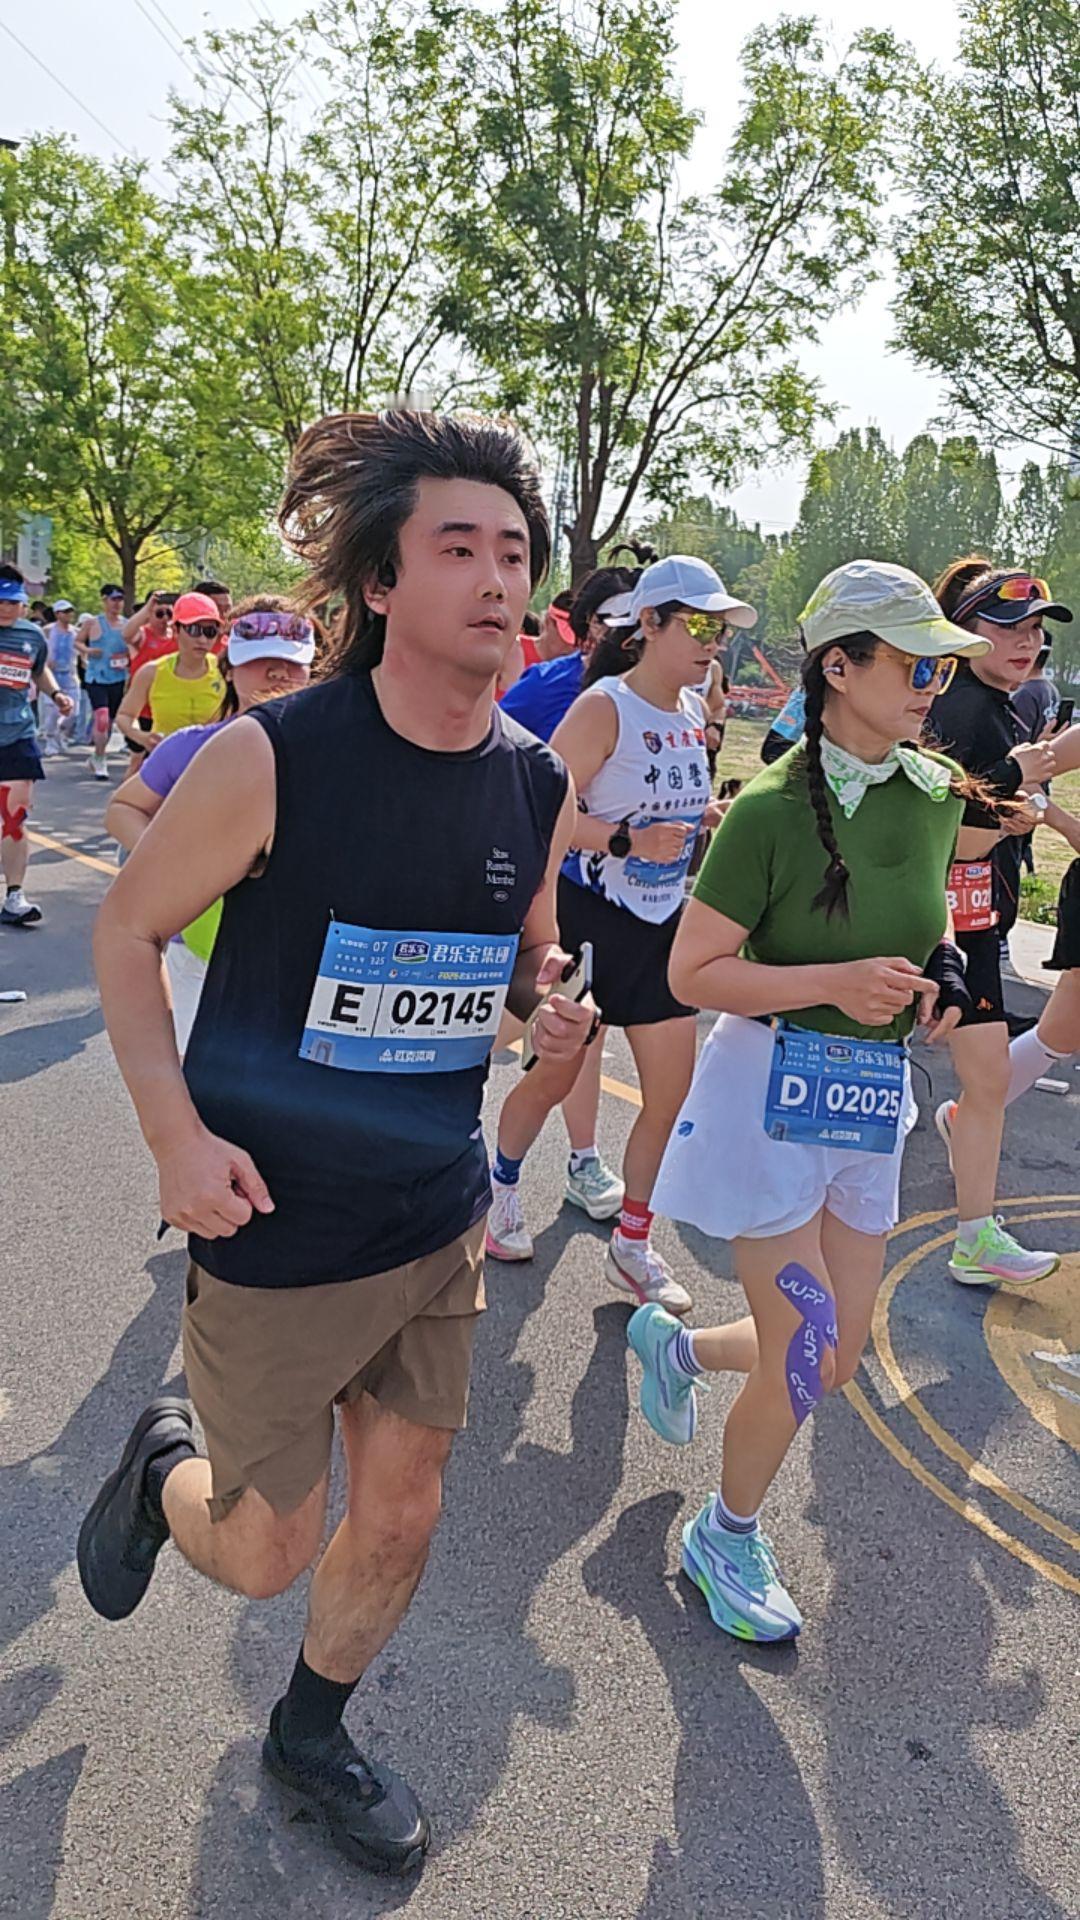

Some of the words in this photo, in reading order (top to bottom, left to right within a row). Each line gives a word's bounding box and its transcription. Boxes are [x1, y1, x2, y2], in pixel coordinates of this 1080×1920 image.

[945, 890, 958, 909] B
[373, 941, 388, 952] 07
[399, 943, 426, 954] 君乐宝
[432, 944, 511, 964] 君乐宝集团
[330, 984, 365, 1024] E
[391, 990, 496, 1026] 02145
[780, 1075, 808, 1107] D
[826, 1083, 901, 1118] 02025
